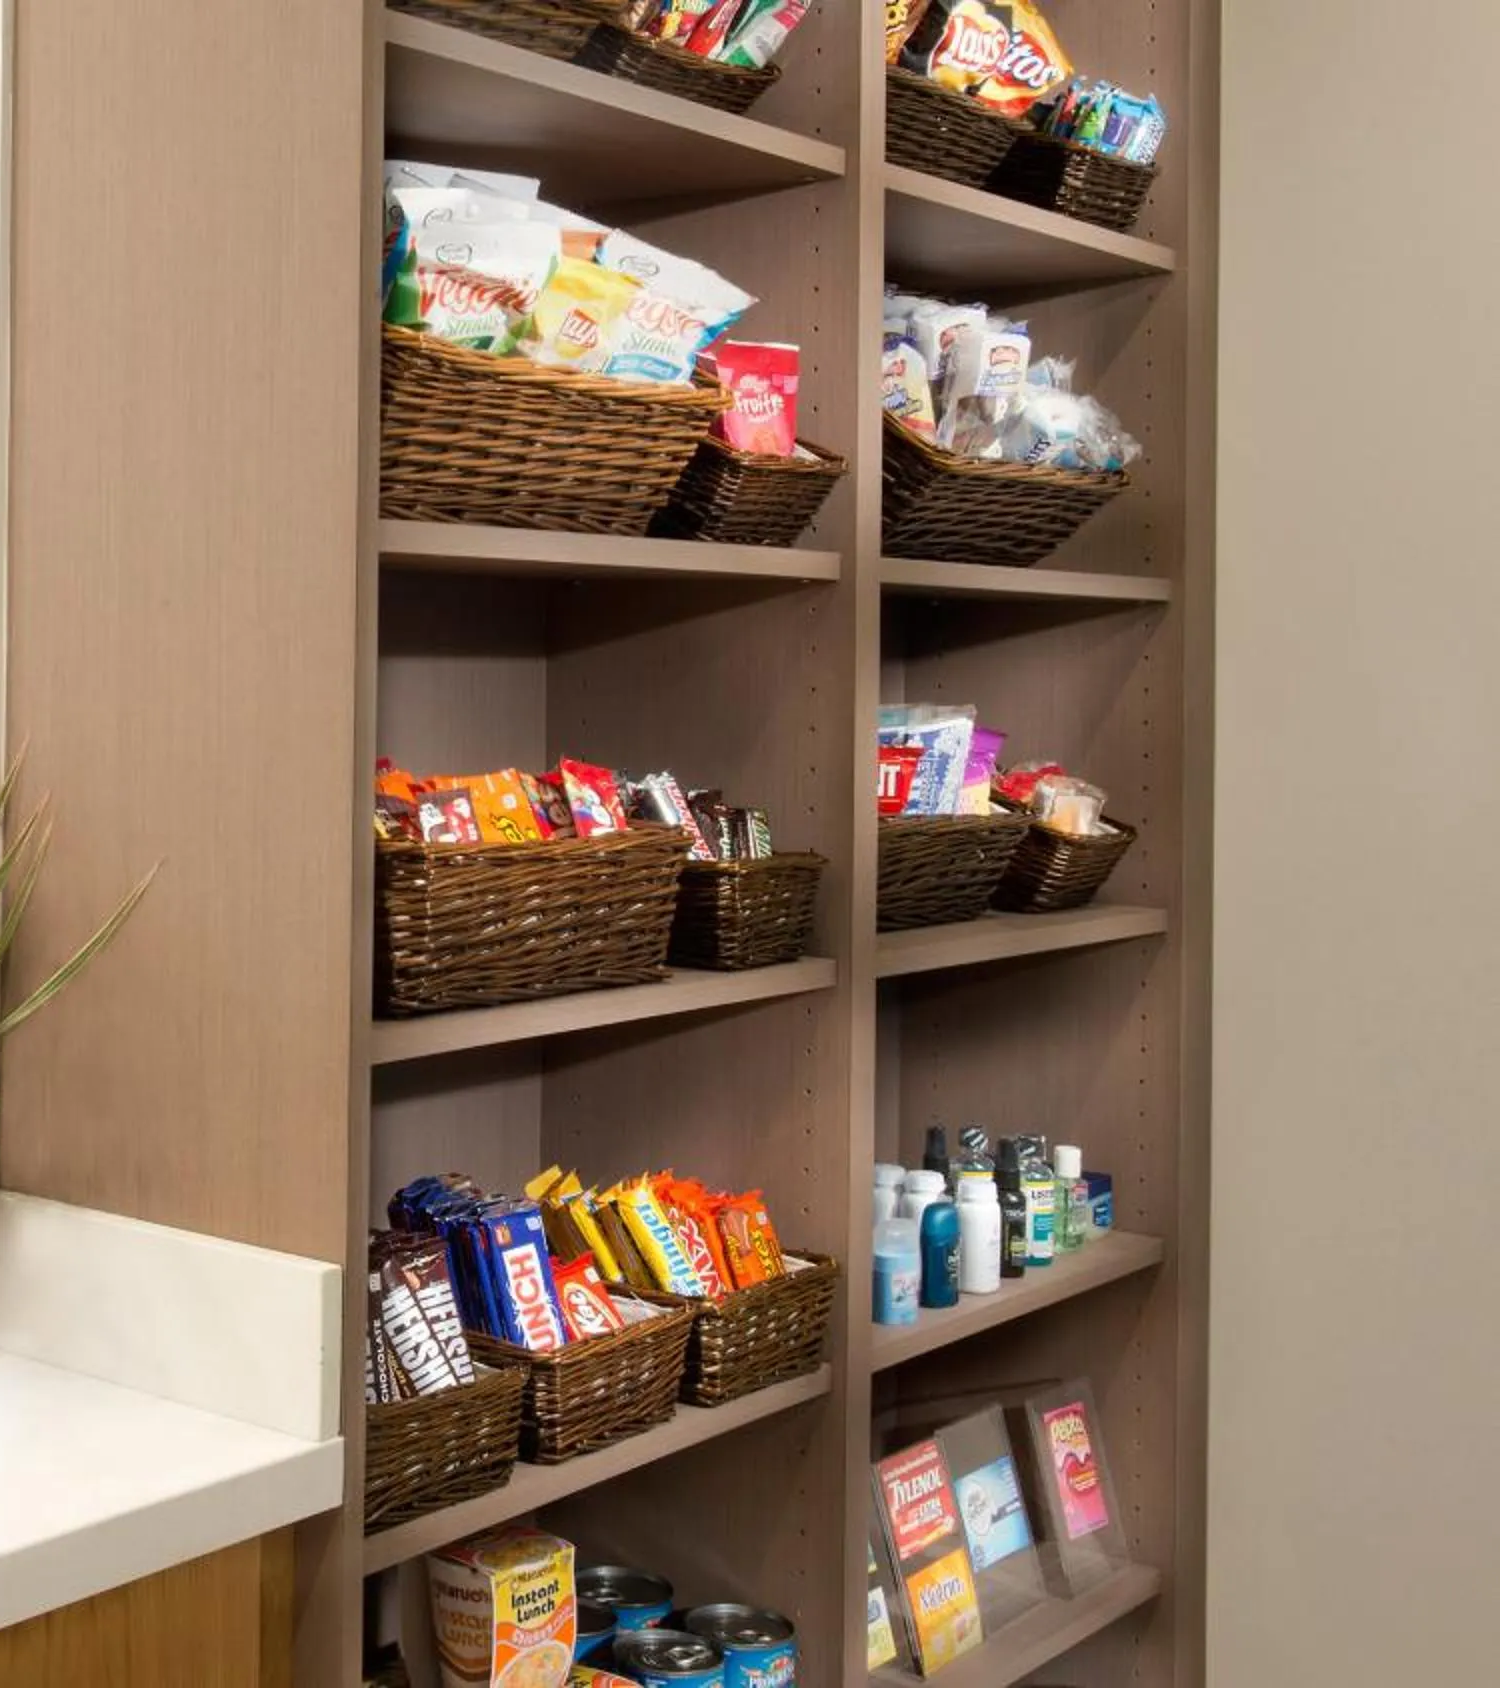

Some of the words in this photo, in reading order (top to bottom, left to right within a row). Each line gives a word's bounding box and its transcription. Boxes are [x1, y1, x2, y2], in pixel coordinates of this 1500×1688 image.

[509, 1250, 558, 1353] UNCH
[373, 1318, 390, 1404] CHOCOLATE
[887, 1465, 945, 1511] TYLENOL
[511, 1579, 560, 1608] Instant
[517, 1600, 556, 1623] Lunch
